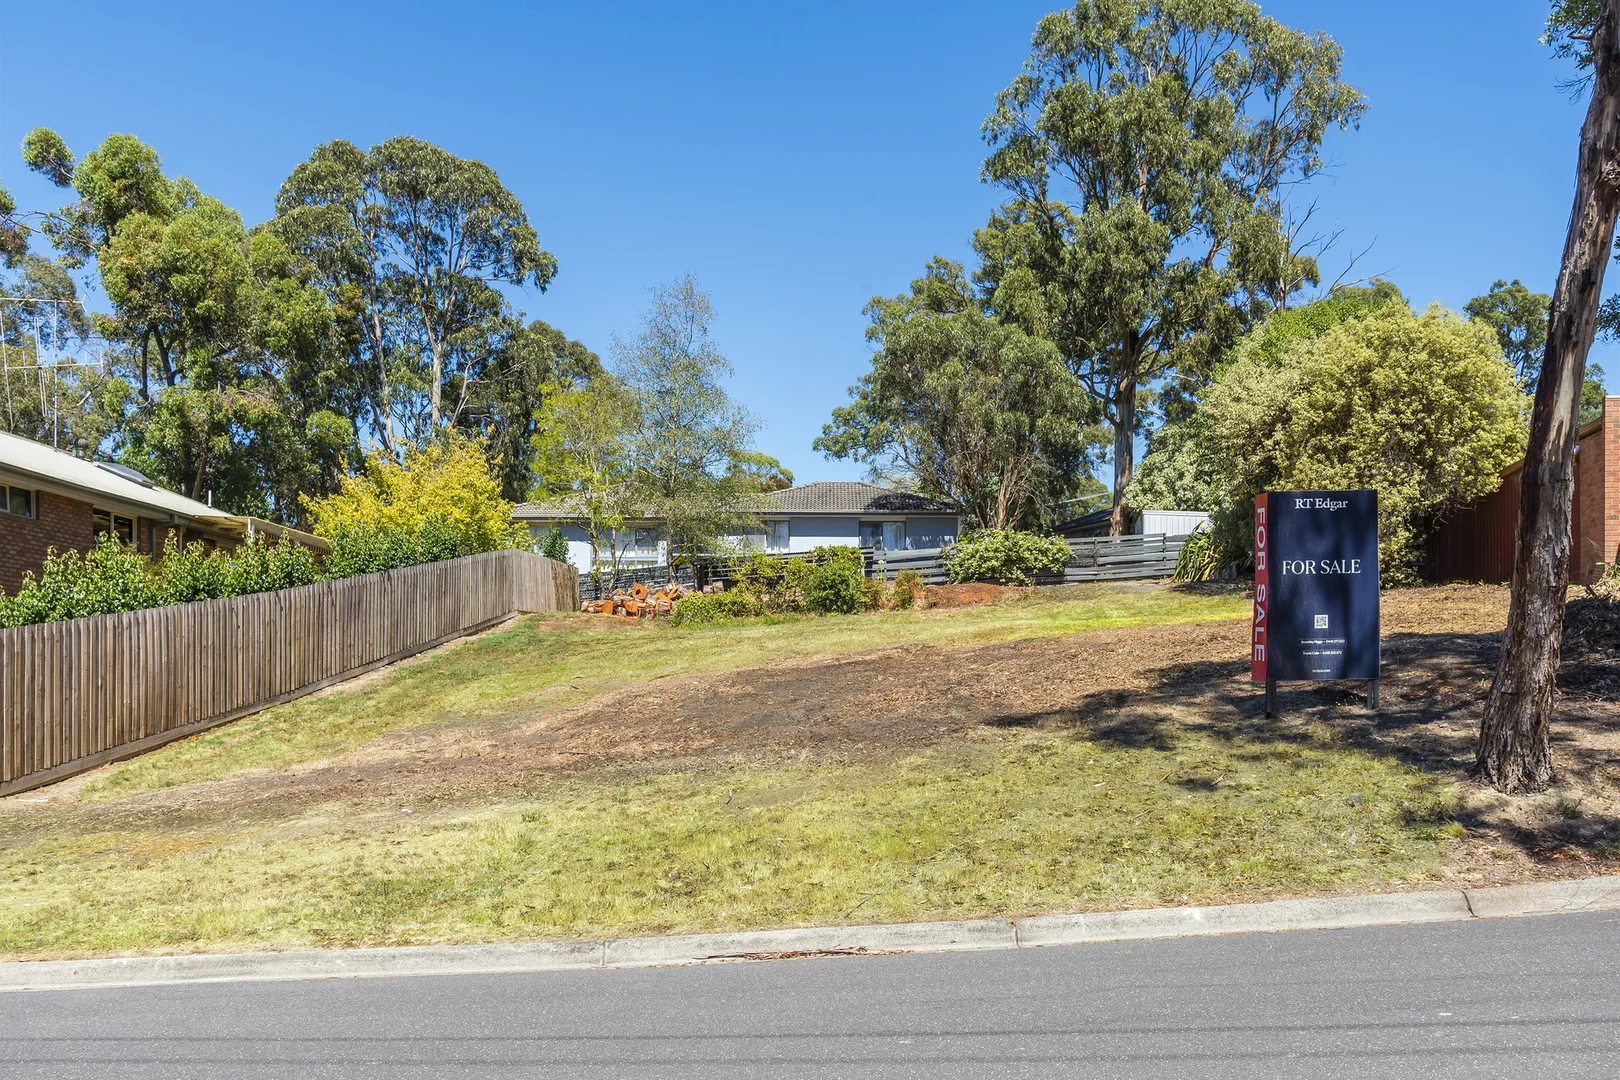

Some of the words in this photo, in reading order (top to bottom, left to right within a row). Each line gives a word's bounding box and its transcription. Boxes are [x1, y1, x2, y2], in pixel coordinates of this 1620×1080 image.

[1295, 498, 1313, 509] RT
[1315, 498, 1348, 511] Edgar
[1257, 507, 1266, 571] FOR
[1282, 560, 1316, 575] FOR
[1320, 559, 1361, 574] SALE
[1254, 583, 1266, 662] SALE
